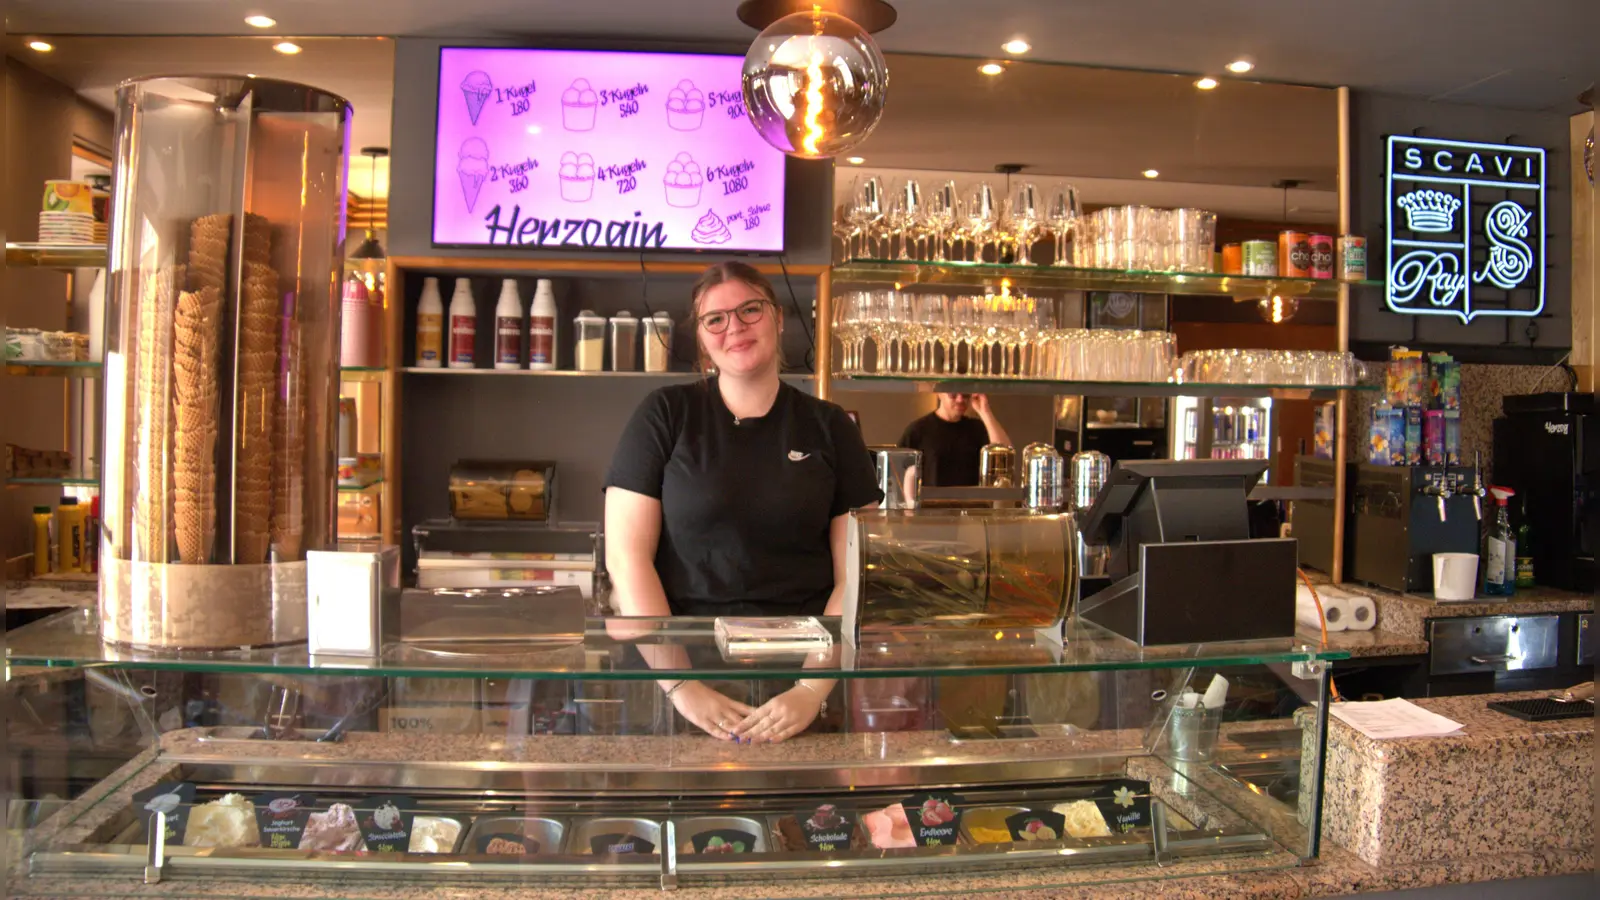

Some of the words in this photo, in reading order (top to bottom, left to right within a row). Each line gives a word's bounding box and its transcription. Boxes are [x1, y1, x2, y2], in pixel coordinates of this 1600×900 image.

[495, 87, 504, 104] 1
[503, 79, 536, 101] Kugel
[600, 89, 608, 106] 3
[608, 82, 649, 103] Kugeln
[708, 91, 716, 108] 5
[716, 90, 742, 106] Kug
[490, 165, 498, 182] 2
[499, 156, 539, 179] Kugeln
[597, 166, 605, 181] 4
[605, 157, 647, 179] Kugeln
[706, 166, 714, 182] 6
[714, 159, 755, 180] Kugeln
[1405, 148, 1531, 177] SCAVI
[1391, 251, 1465, 306] Ray
[391, 716, 433, 730] 100%
[1116, 811, 1141, 824] Vanille
[809, 831, 848, 843] Schokolade
